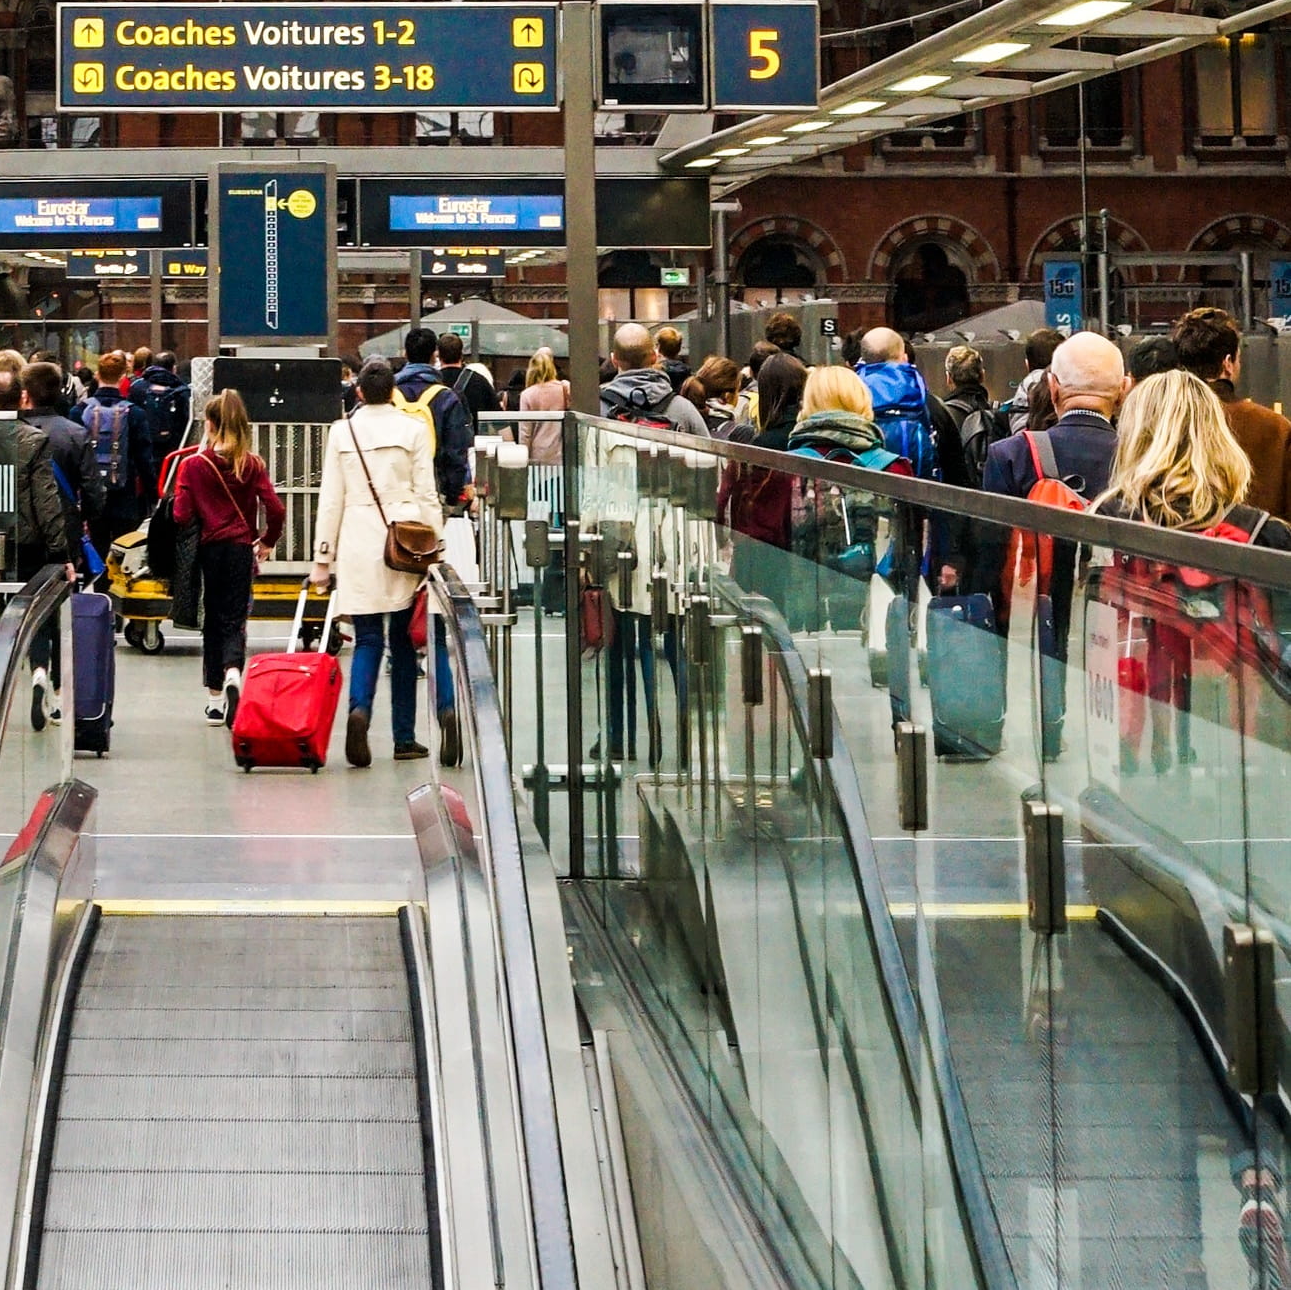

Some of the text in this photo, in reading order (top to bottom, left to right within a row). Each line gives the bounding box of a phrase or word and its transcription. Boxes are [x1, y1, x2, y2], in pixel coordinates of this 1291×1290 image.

[116, 19, 416, 46] Coaches Voitures 1-2
[749, 30, 780, 79] 5
[116, 63, 434, 91] Coaches Voitures 3-18
[37, 199, 90, 216] Eurostar
[438, 196, 492, 213] Eurostar
[14, 214, 54, 227] Welcome
[55, 215, 65, 226] to
[79, 215, 114, 226] Pancras
[415, 212, 455, 224] Welcome
[456, 212, 466, 224] to
[480, 213, 516, 224] Pancras
[183, 264, 207, 276] Way
[823, 319, 835, 331] S
